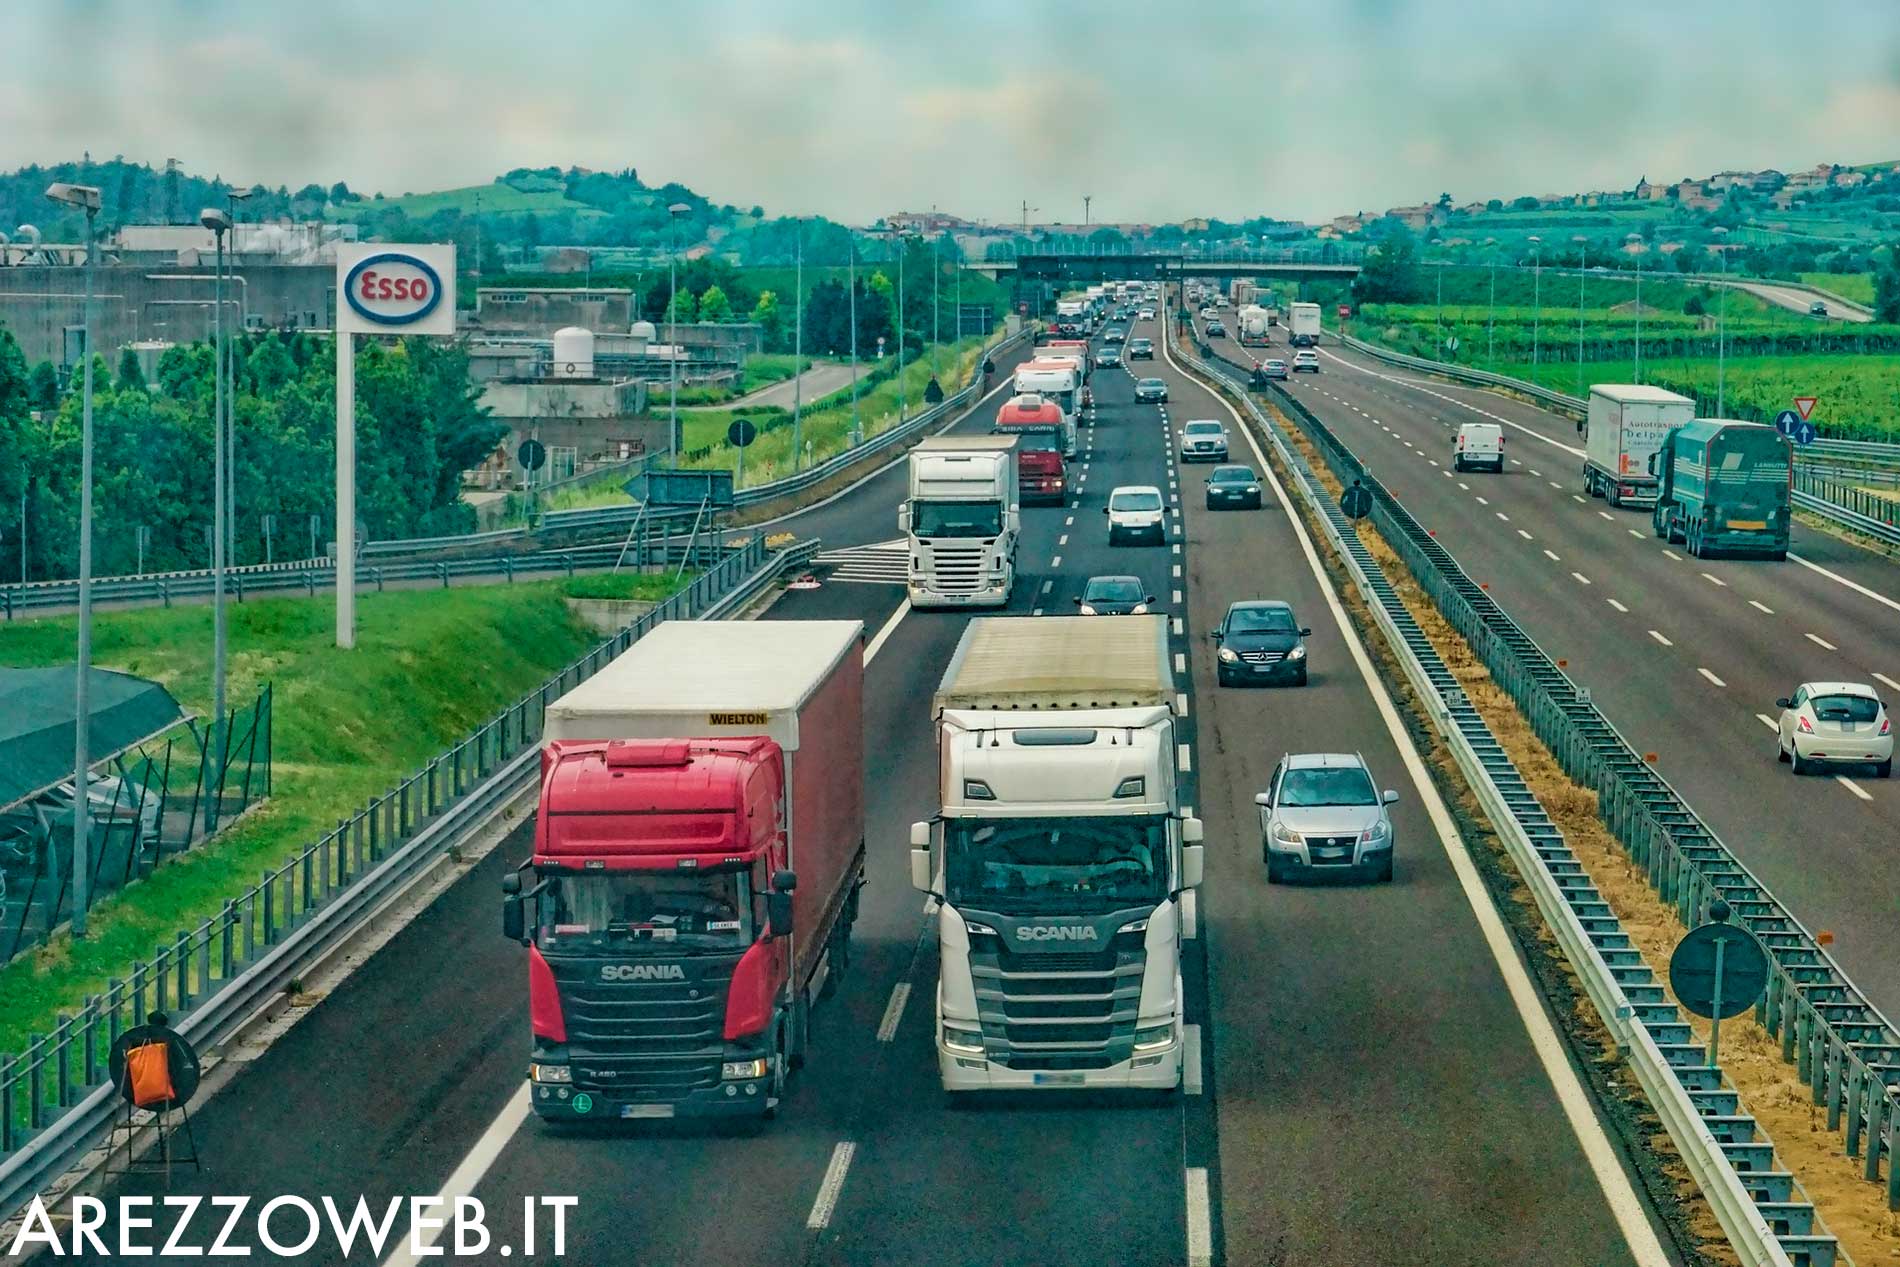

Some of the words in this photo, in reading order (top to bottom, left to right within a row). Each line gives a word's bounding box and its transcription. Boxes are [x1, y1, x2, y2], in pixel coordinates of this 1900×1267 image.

[361, 271, 427, 301] Esso
[710, 713, 765, 725] WIELTON
[1016, 926, 1098, 941] SCANIA
[601, 964, 685, 981] SCANIA
